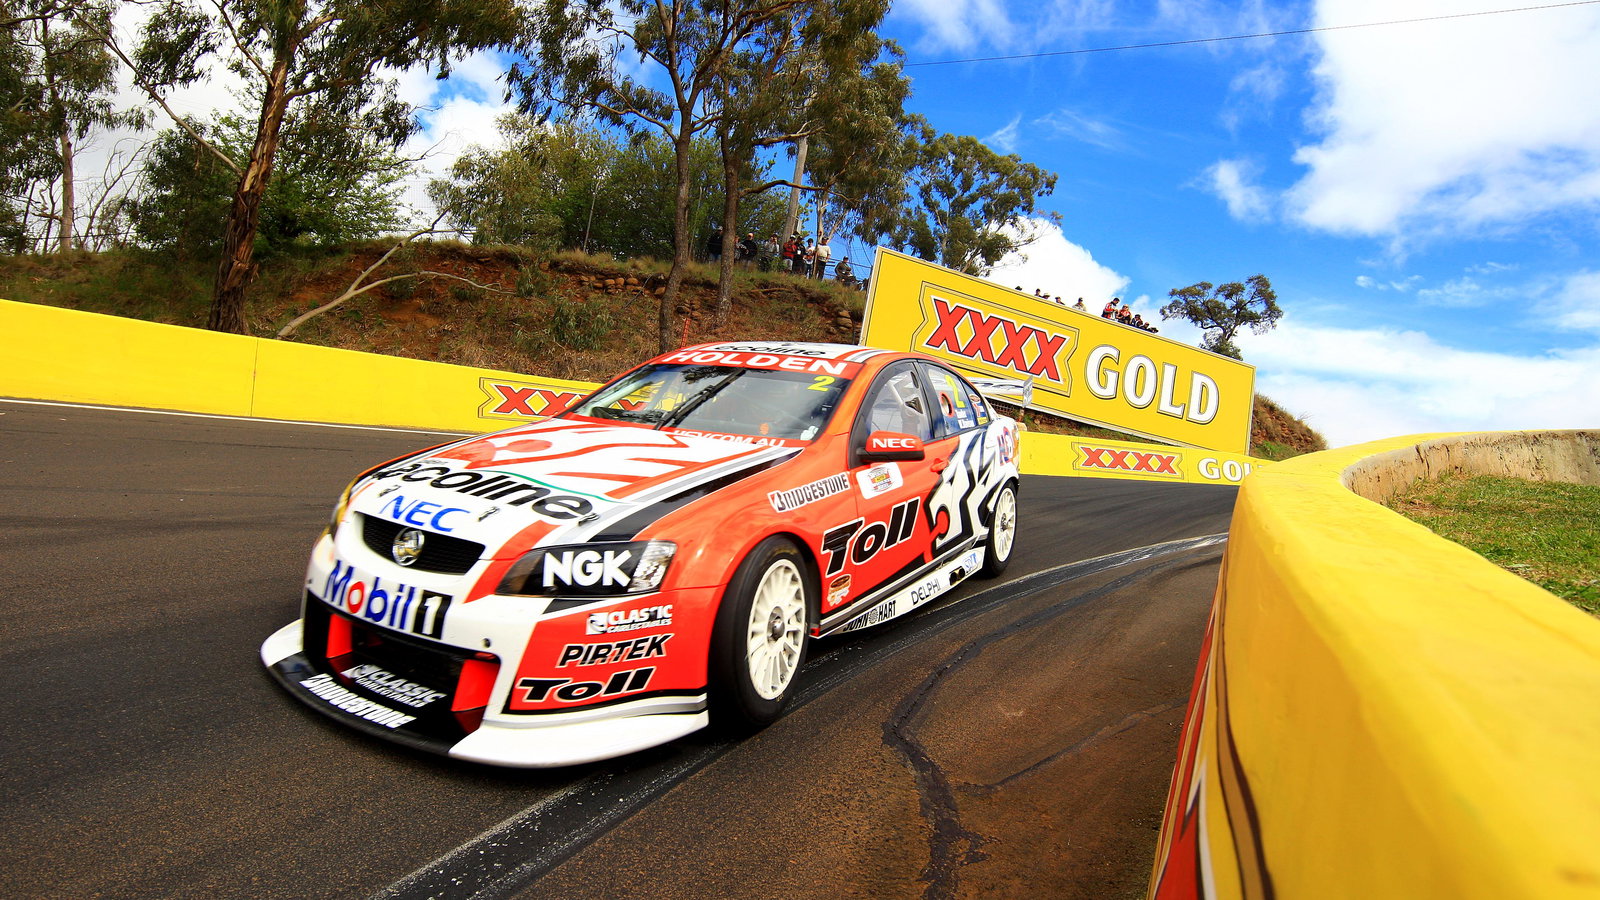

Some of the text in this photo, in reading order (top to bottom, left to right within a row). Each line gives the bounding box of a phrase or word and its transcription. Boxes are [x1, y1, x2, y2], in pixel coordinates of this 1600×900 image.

[662, 351, 847, 375] HOLDEN
[926, 297, 1220, 425] XXXX GOLD
[807, 375, 837, 392] 2
[872, 438, 917, 449] NEC
[1080, 447, 1178, 475] XXXX
[374, 463, 593, 520] ecoline
[771, 473, 850, 512] BRIDGESTONE
[378, 495, 471, 532] NEC
[822, 497, 920, 577] Toll
[542, 549, 633, 588] NGK
[323, 560, 444, 636] Mobil 1
[910, 578, 941, 606] DELPHI
[608, 605, 673, 625] CLASIC
[843, 600, 897, 632] JOHN HART
[556, 634, 674, 668] PIRTEK
[367, 670, 447, 703] CLASSIC
[517, 667, 656, 702] Toll
